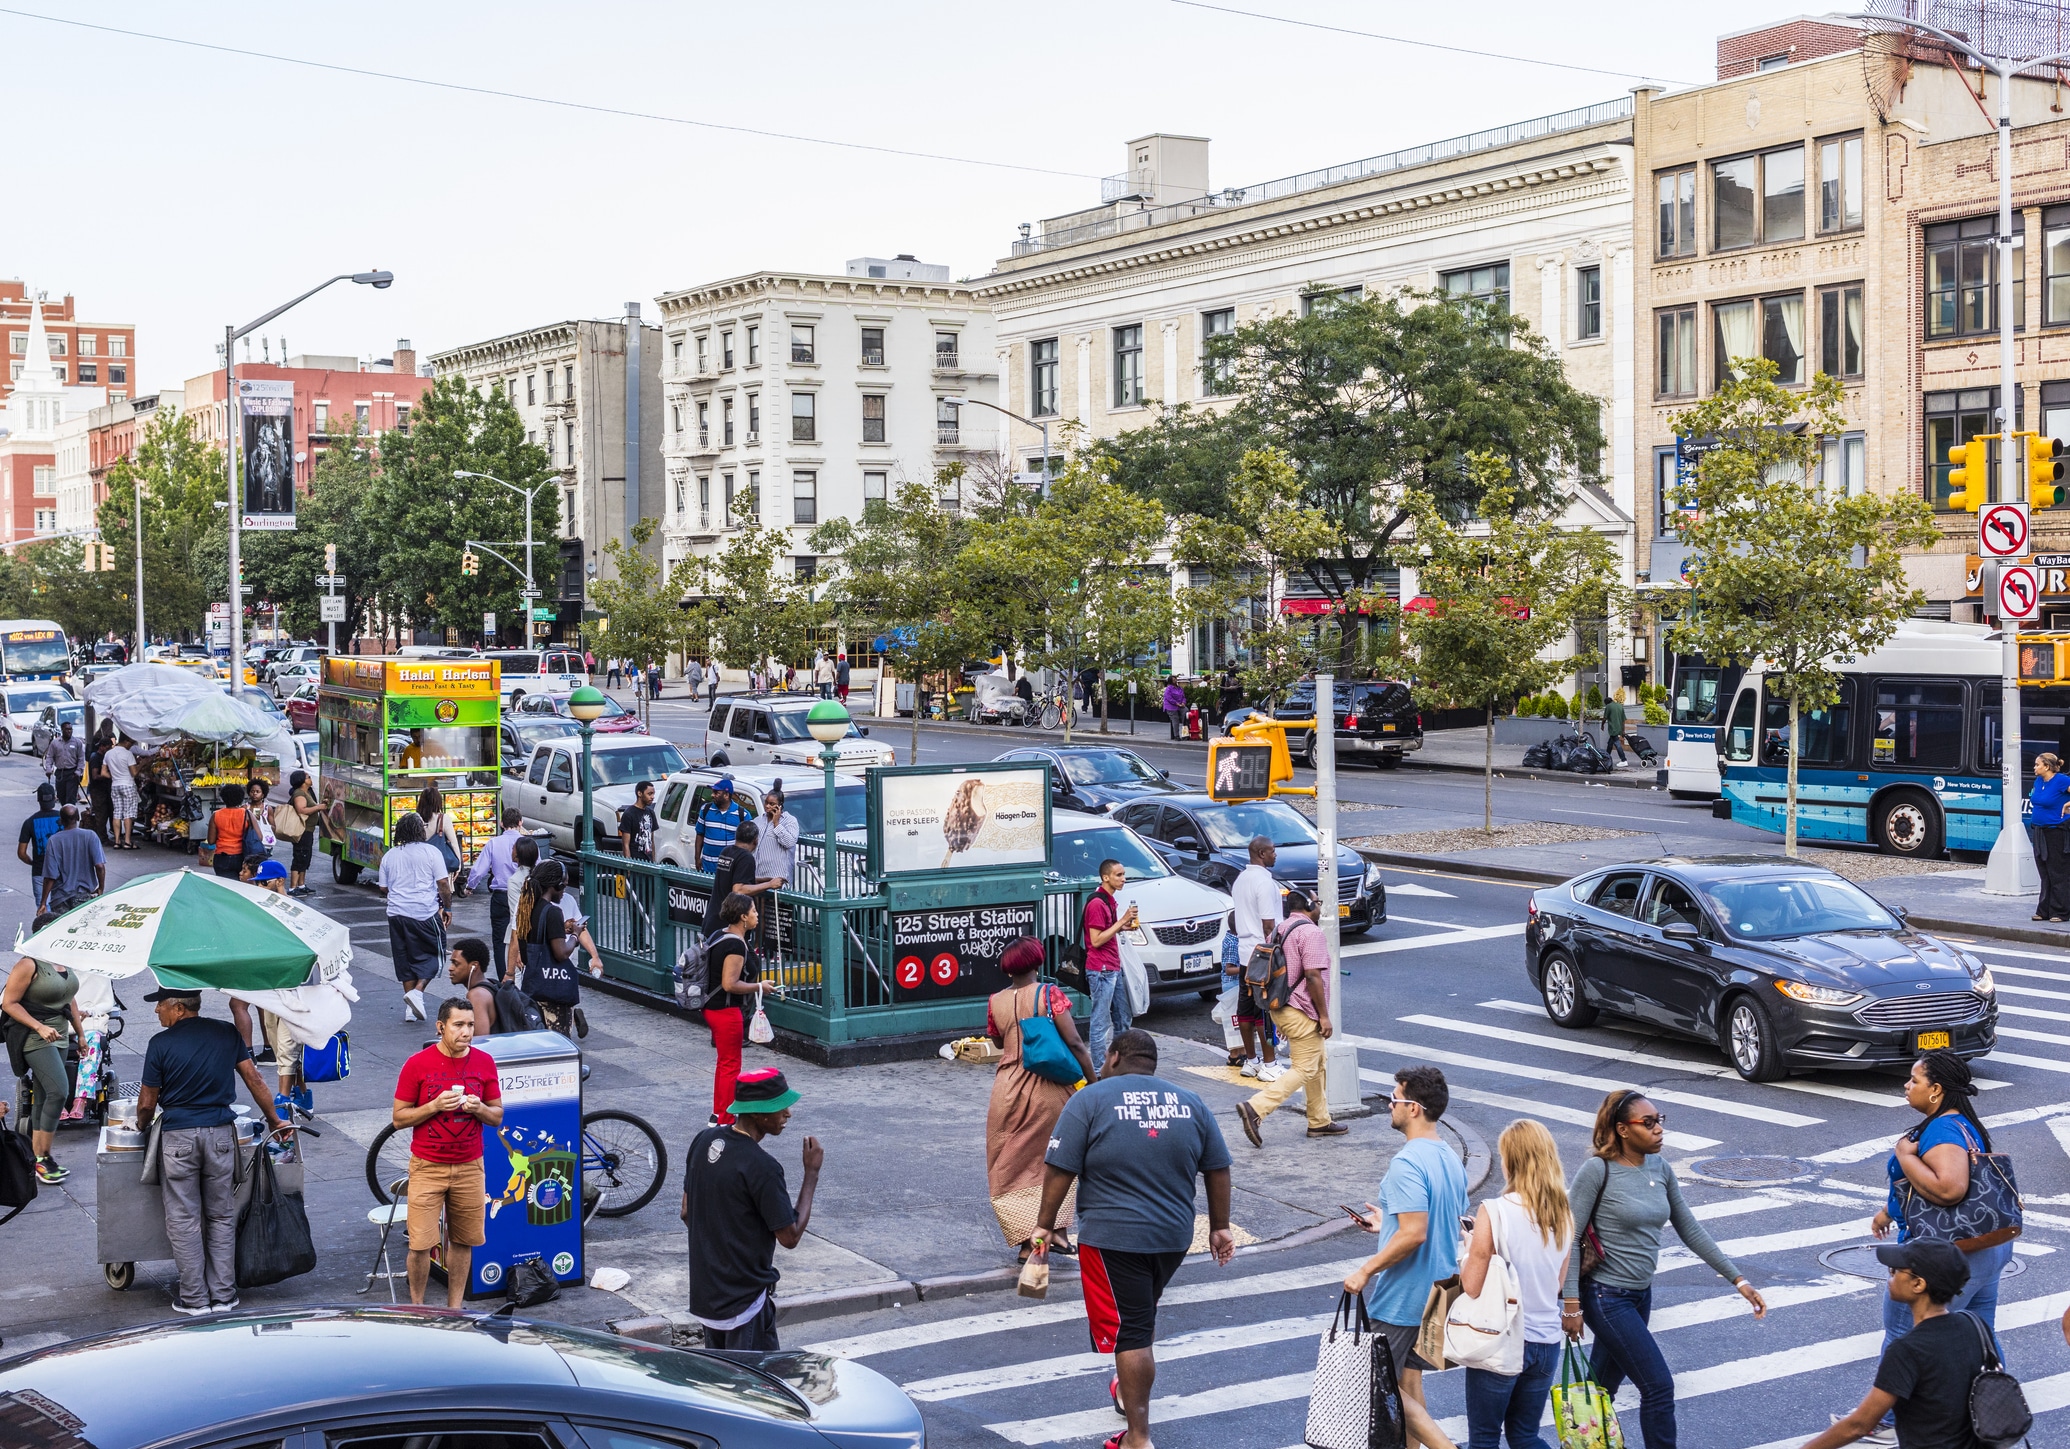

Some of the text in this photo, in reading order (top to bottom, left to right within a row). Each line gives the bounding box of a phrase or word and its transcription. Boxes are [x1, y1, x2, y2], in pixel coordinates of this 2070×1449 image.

[244, 398, 261, 406] Music
[268, 399, 291, 407] Fashion
[244, 517, 295, 528] Burlington
[35, 631, 46, 639] LEX
[400, 669, 491, 682] Halal Harlem
[411, 682, 431, 690] Fresh,
[889, 808, 936, 817] OUR PASSION
[886, 816, 939, 826] NEVER SLEEPS
[668, 888, 709, 918] Subway
[895, 908, 1034, 933] 125 Street Station
[895, 926, 1016, 946] Downtown & Brooklyn
[50, 939, 127, 954] (718) 292-1930
[541, 967, 571, 980] A.P.C.
[904, 959, 952, 982] 2 3
[1919, 1033, 1948, 1047] 707561C
[1123, 1091, 1179, 1105] BEST IN
[1114, 1104, 1191, 1120] THE WORLD
